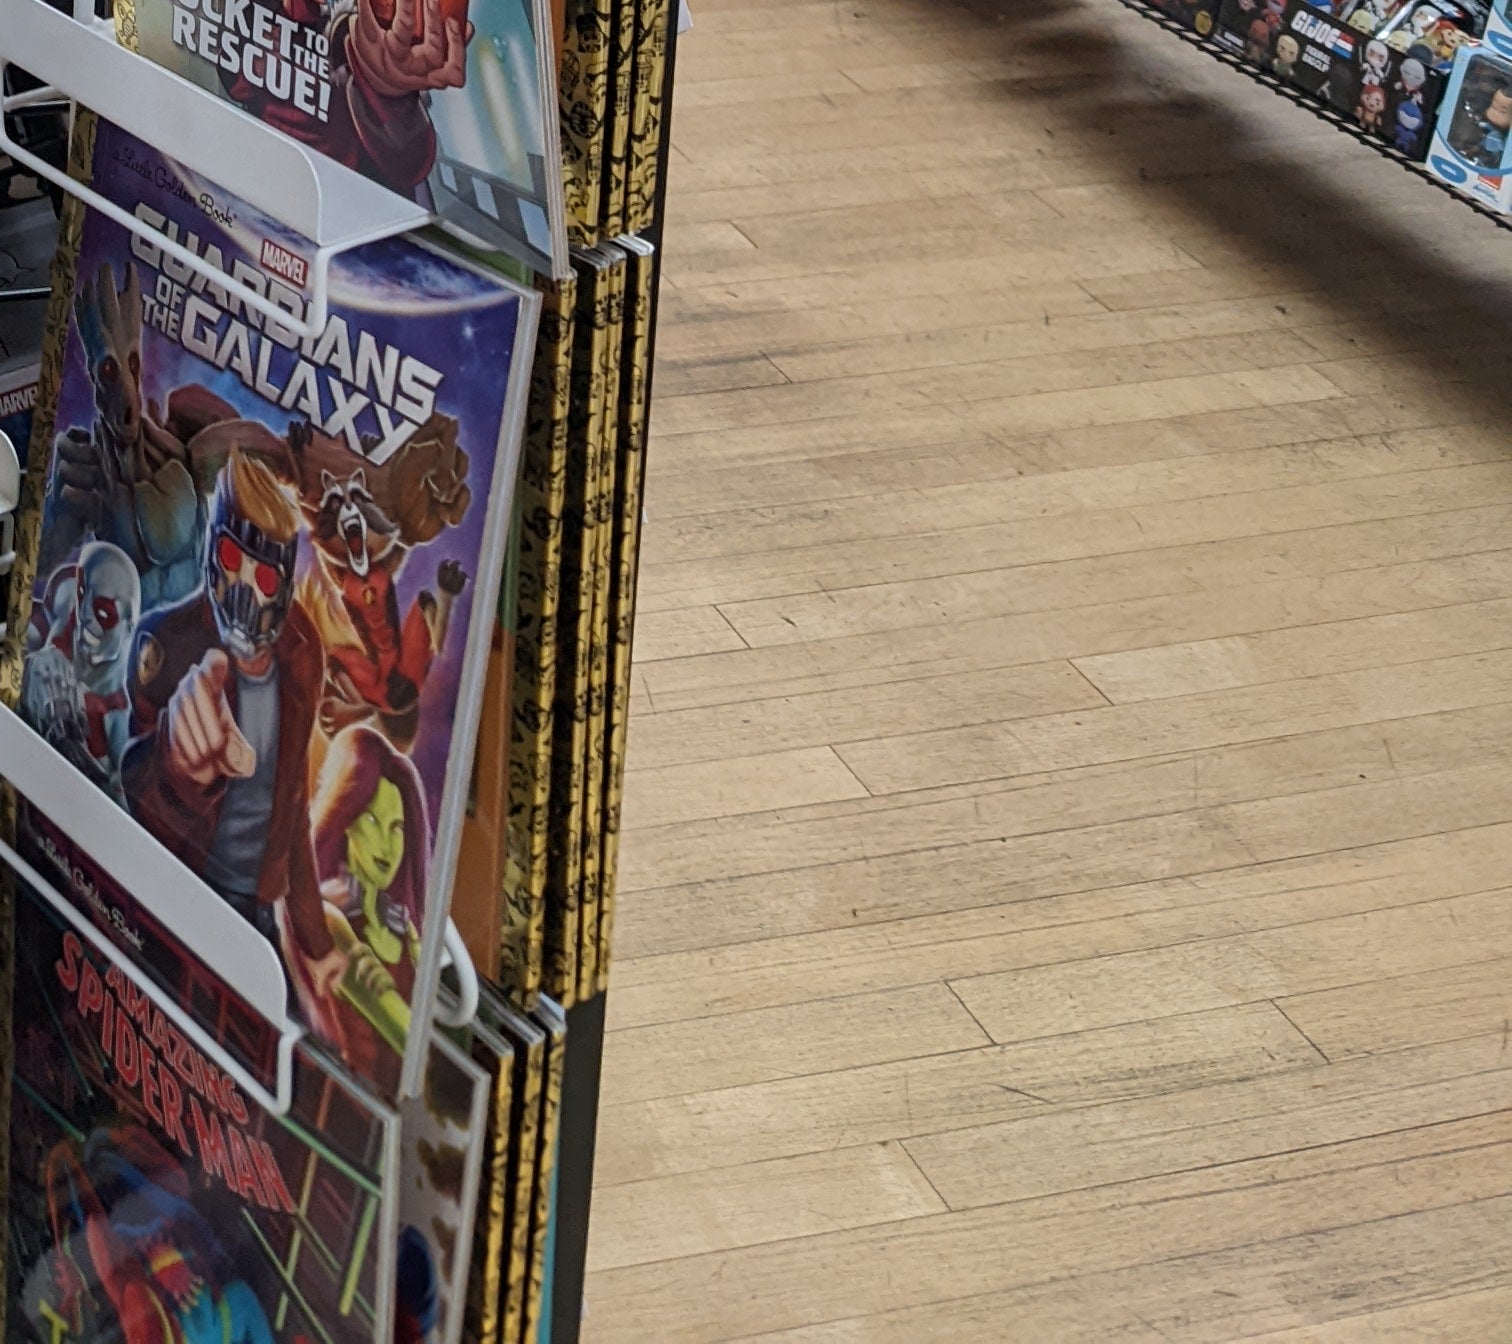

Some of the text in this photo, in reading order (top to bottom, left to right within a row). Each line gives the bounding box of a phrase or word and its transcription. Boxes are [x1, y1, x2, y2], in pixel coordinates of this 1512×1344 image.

[172, 4, 332, 123] RESCUE!
[294, 46, 331, 79] THE
[303, 27, 329, 55] TO
[199, 193, 233, 229] Book
[261, 240, 309, 286] MARVEL
[141, 274, 187, 342] OF THE
[181, 297, 421, 467] GALAXY
